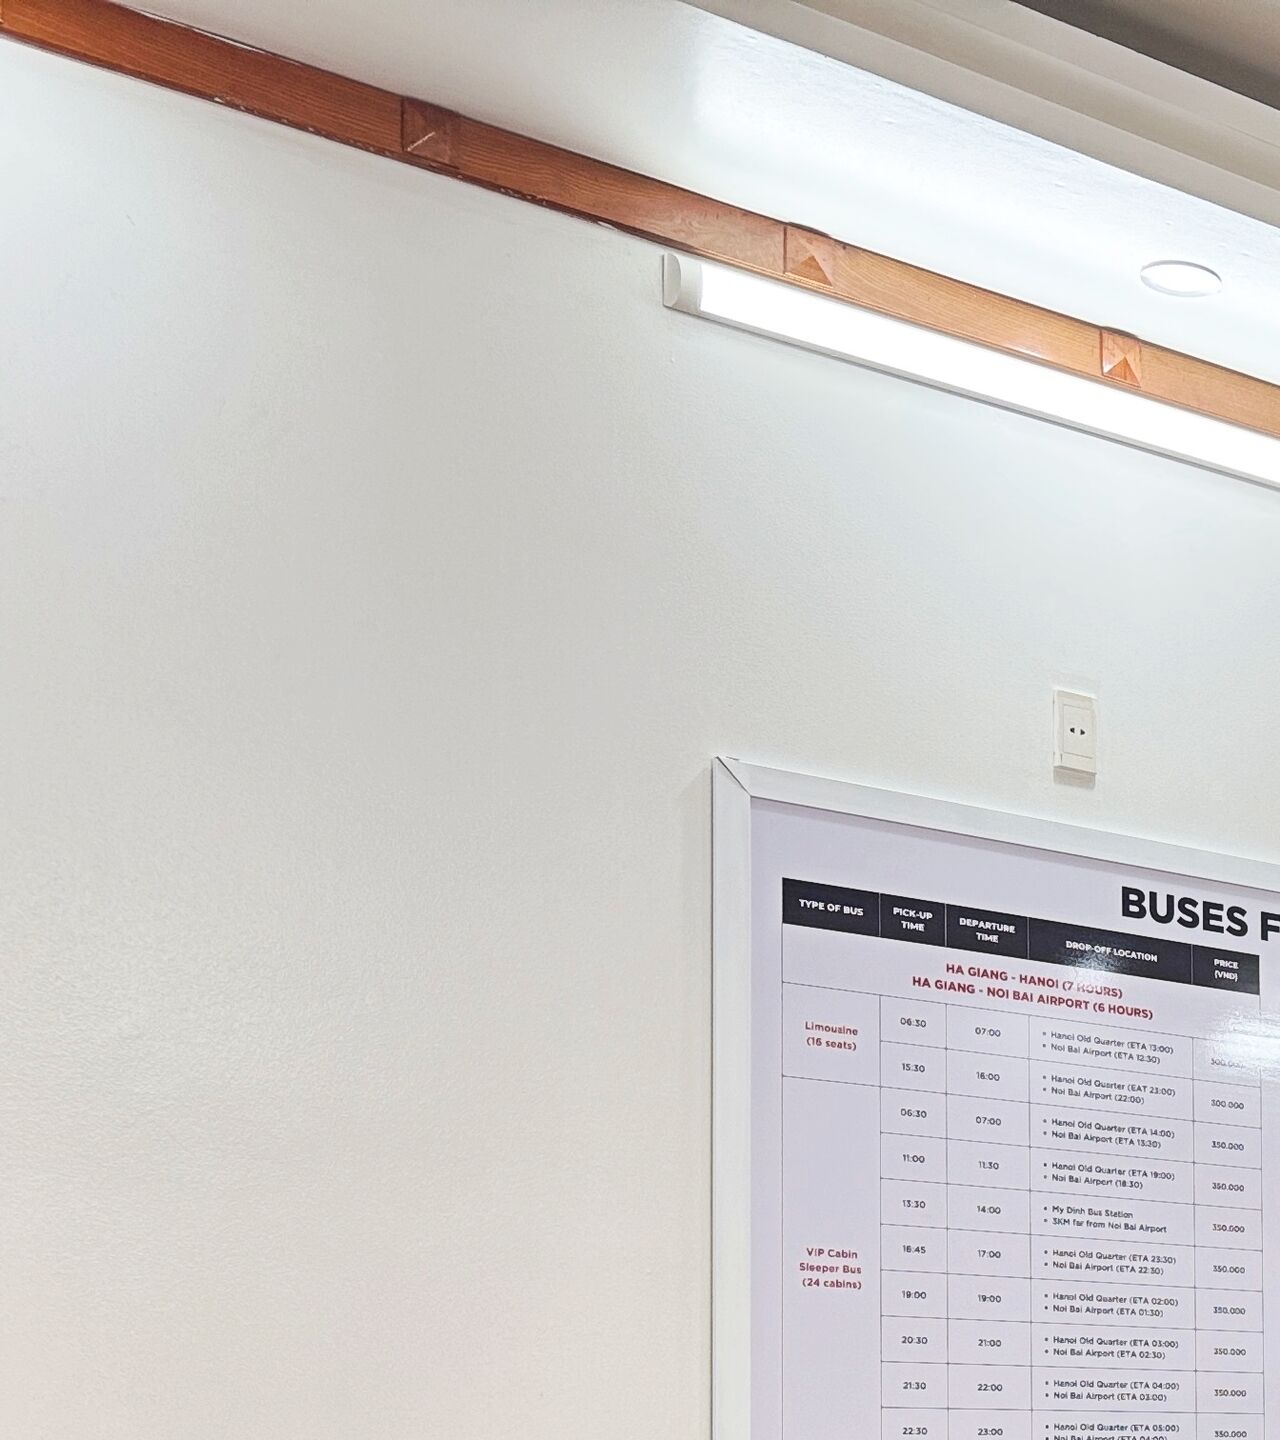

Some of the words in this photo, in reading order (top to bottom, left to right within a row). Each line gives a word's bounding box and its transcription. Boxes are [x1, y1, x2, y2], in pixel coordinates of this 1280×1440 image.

[798, 898, 826, 911] TYPE
[826, 902, 842, 913] OF
[843, 905, 864, 916] BUS
[892, 906, 933, 920] PICK-UP
[1121, 885, 1249, 938] BUSES
[900, 920, 925, 932] TIME
[959, 917, 1016, 934] DEPARTURE
[975, 931, 999, 944] TIME
[1065, 940, 1112, 958] DROP-OFF
[1112, 947, 1158, 963] LOCATION
[1213, 958, 1239, 970] PRICE
[945, 963, 965, 976] HA
[967, 966, 1009, 982] GIANG
[1019, 973, 1059, 989] HANOI
[1061, 980, 1074, 992] (7
[1214, 969, 1239, 983] (VND)
[912, 975, 931, 989] HA
[934, 979, 976, 995] GIANG
[986, 986, 1010, 999] NOI
[1012, 989, 1034, 1003] BAI
[1036, 993, 1090, 1010] AIRPORT
[1092, 1002, 1106, 1013] (6
[1108, 1003, 1153, 1021] HOURS)
[804, 1020, 859, 1036] Limousine
[806, 1247, 825, 1257] VIP
[827, 1248, 858, 1260] Cabin
[799, 1262, 840, 1274] Sleeper
[842, 1264, 862, 1275] Bus
[802, 1277, 820, 1288] (24
[822, 1278, 862, 1291] cabins)
